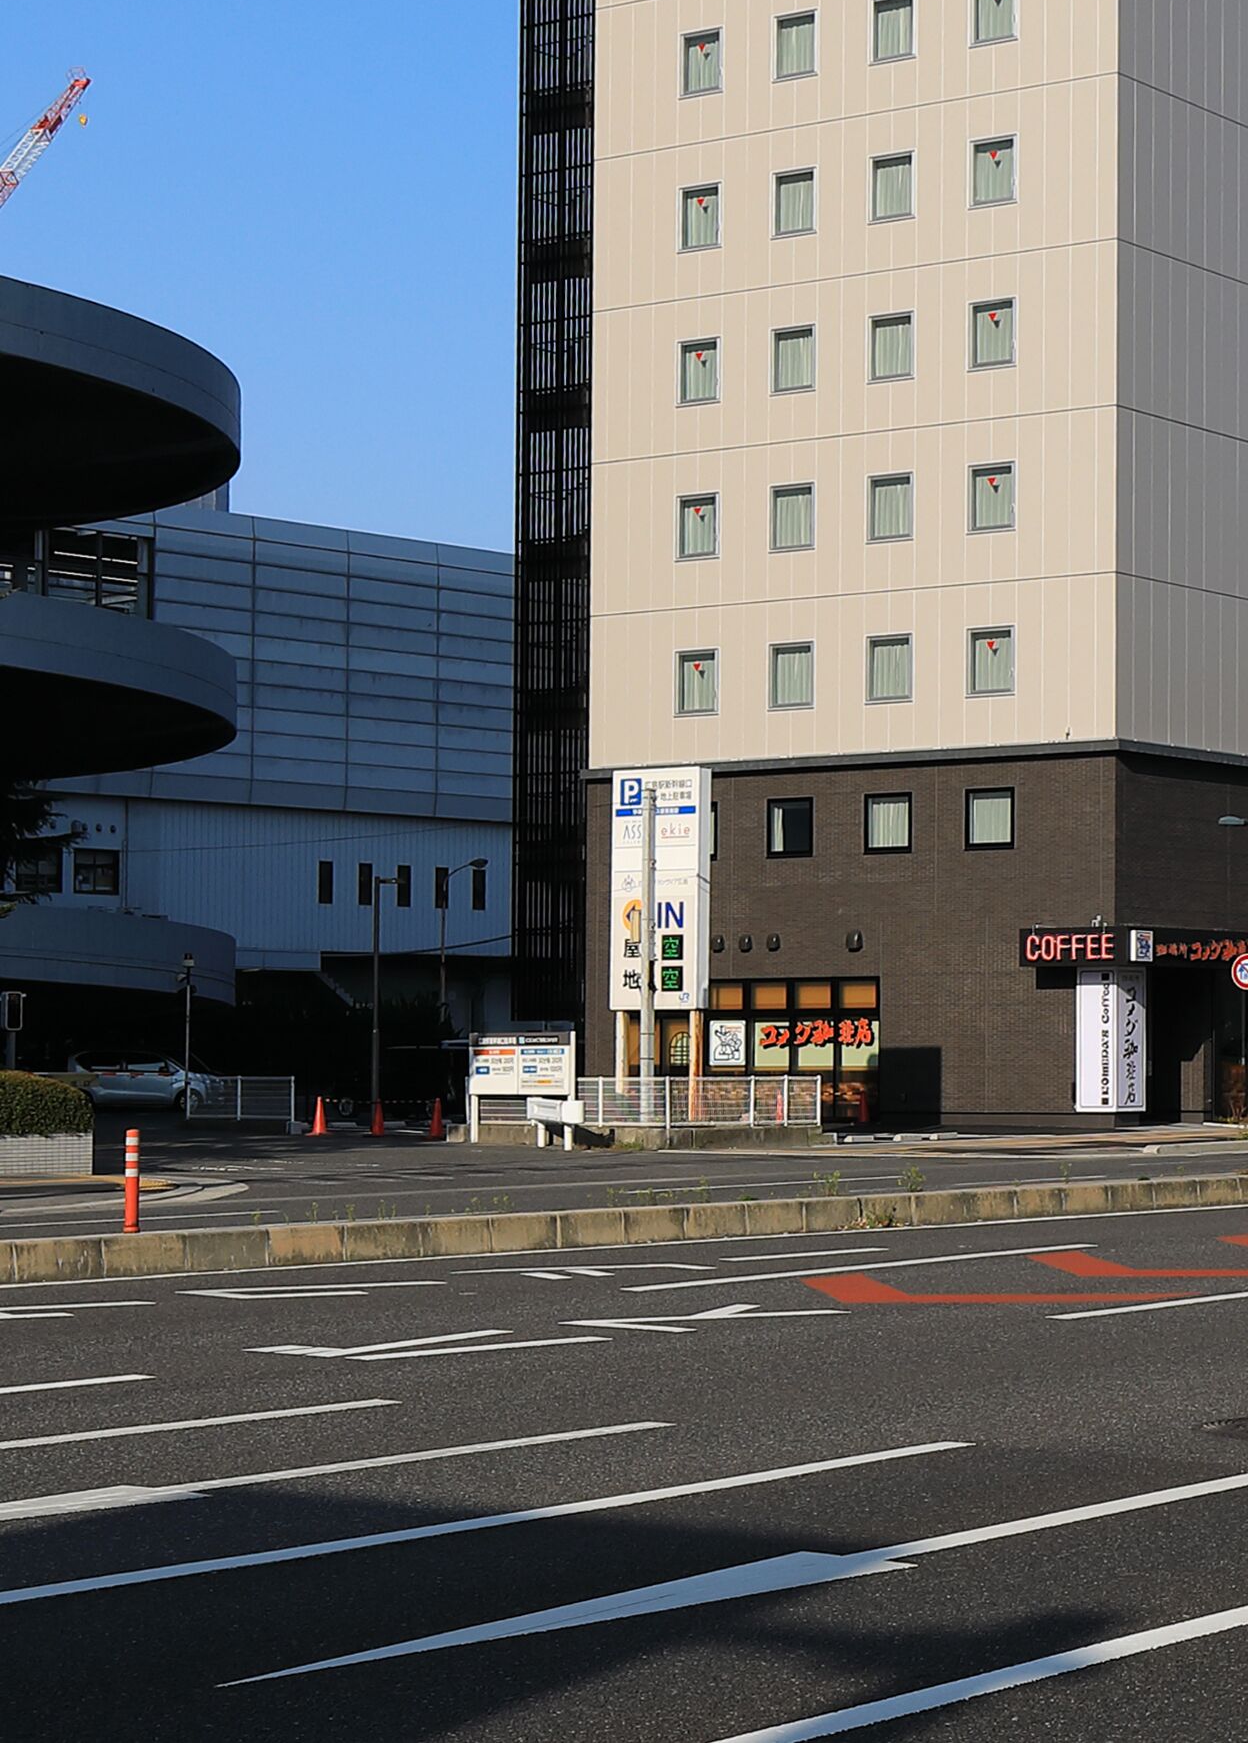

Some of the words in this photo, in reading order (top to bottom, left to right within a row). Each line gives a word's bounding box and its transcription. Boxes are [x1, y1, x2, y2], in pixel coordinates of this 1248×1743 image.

[661, 823, 690, 836] ekie
[657, 902, 684, 929] IN
[1026, 933, 1115, 961] COFFEE
[760, 1018, 872, 1046] コメダ珈琲店
